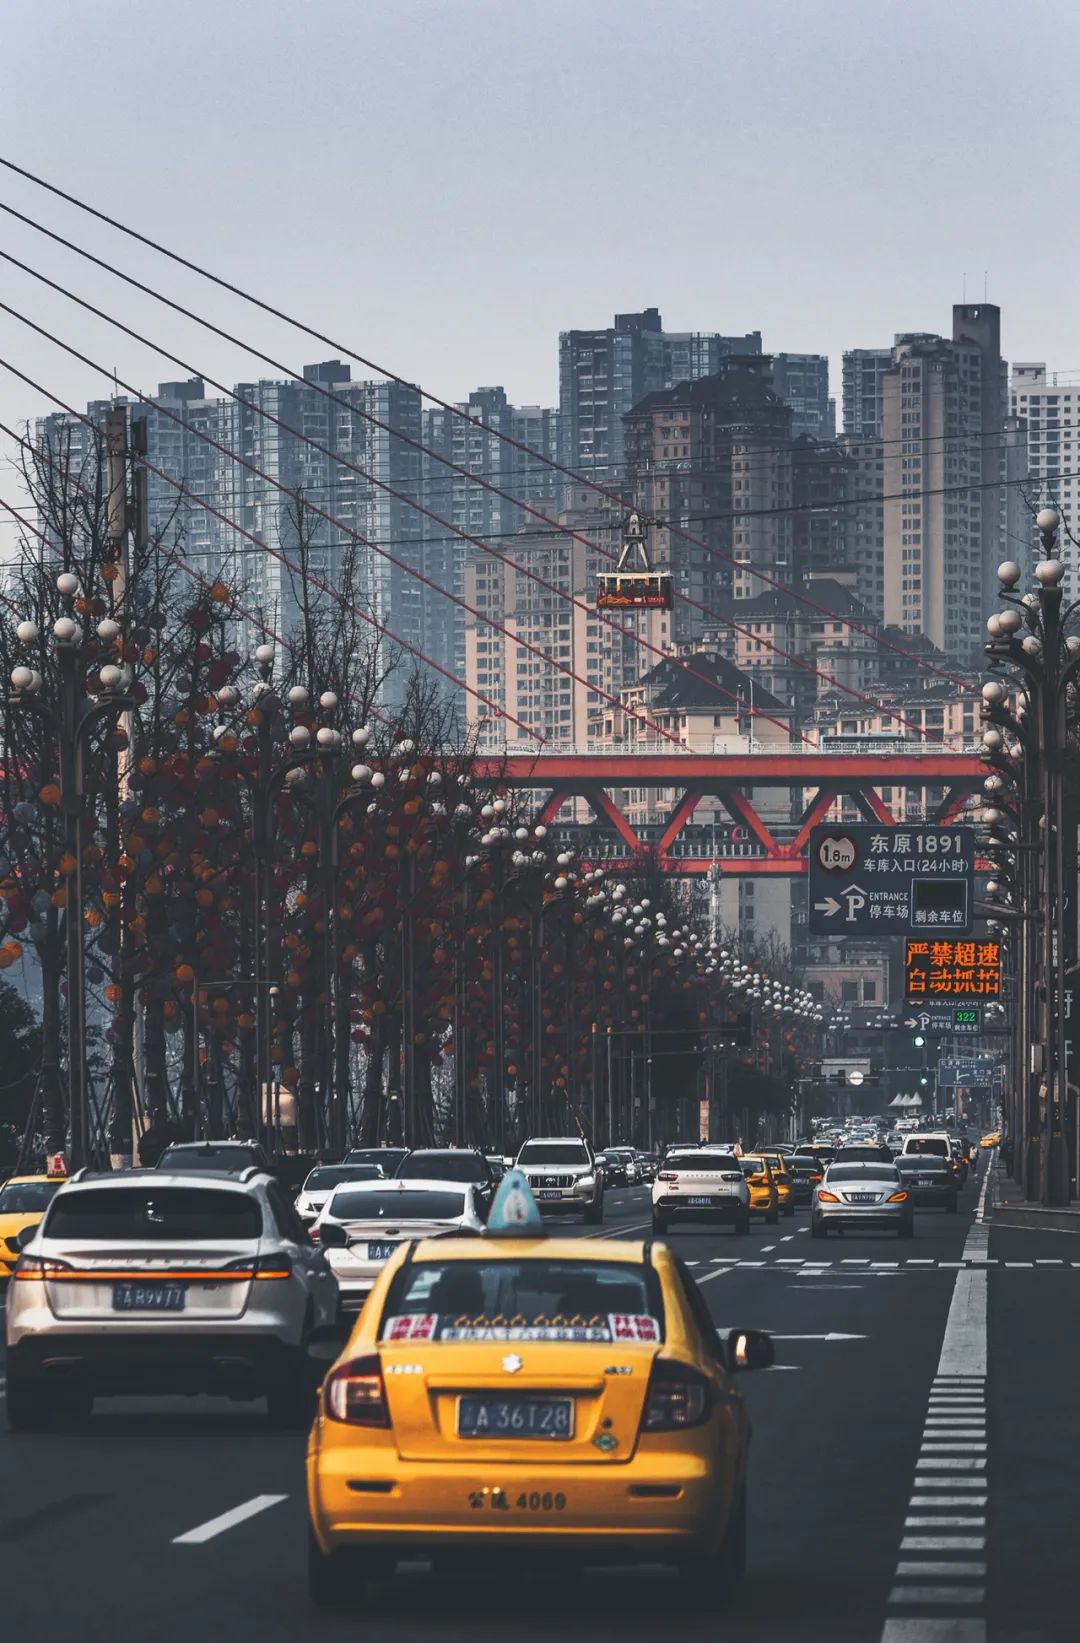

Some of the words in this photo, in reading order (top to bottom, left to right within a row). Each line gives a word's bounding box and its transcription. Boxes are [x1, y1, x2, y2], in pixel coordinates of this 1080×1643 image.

[823, 844, 851, 863] 1.8m
[863, 858, 969, 873] 车库入口(24小时)
[869, 892, 909, 901] ENTRANCE
[845, 895, 865, 922] P
[869, 904, 909, 919] 停车场
[915, 910, 964, 923] 剩余车位
[907, 942, 999, 966] 严禁超速
[909, 968, 999, 993] 自动抓拍
[956, 1011, 976, 1022] 322
